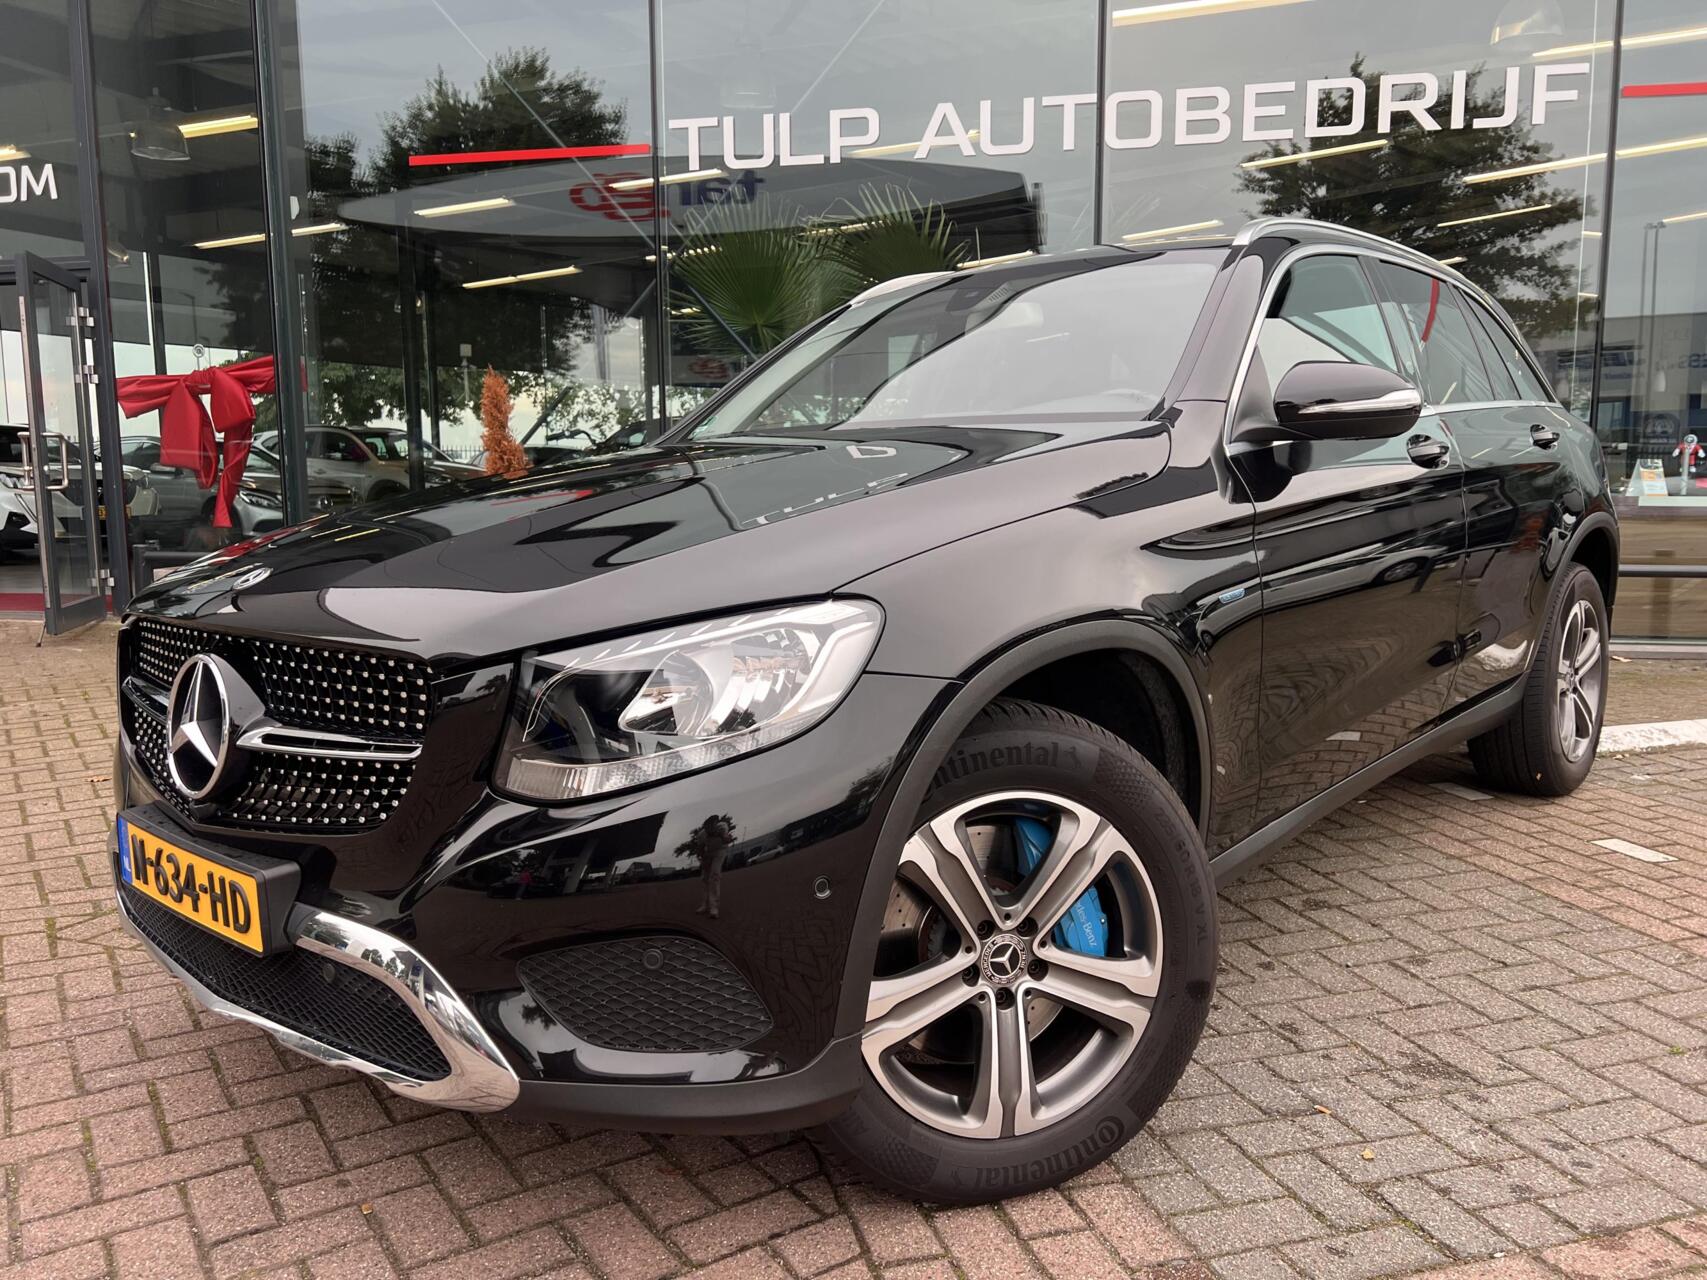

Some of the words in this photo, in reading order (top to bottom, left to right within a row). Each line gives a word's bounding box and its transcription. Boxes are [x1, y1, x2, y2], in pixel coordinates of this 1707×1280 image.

[668, 107, 880, 171] TULP
[914, 62, 1590, 159] AUTOBEDRIJF
[924, 742, 1060, 803] ntinental
[131, 833, 251, 934] N-634-HD
[975, 1115, 1126, 1192] Continental
